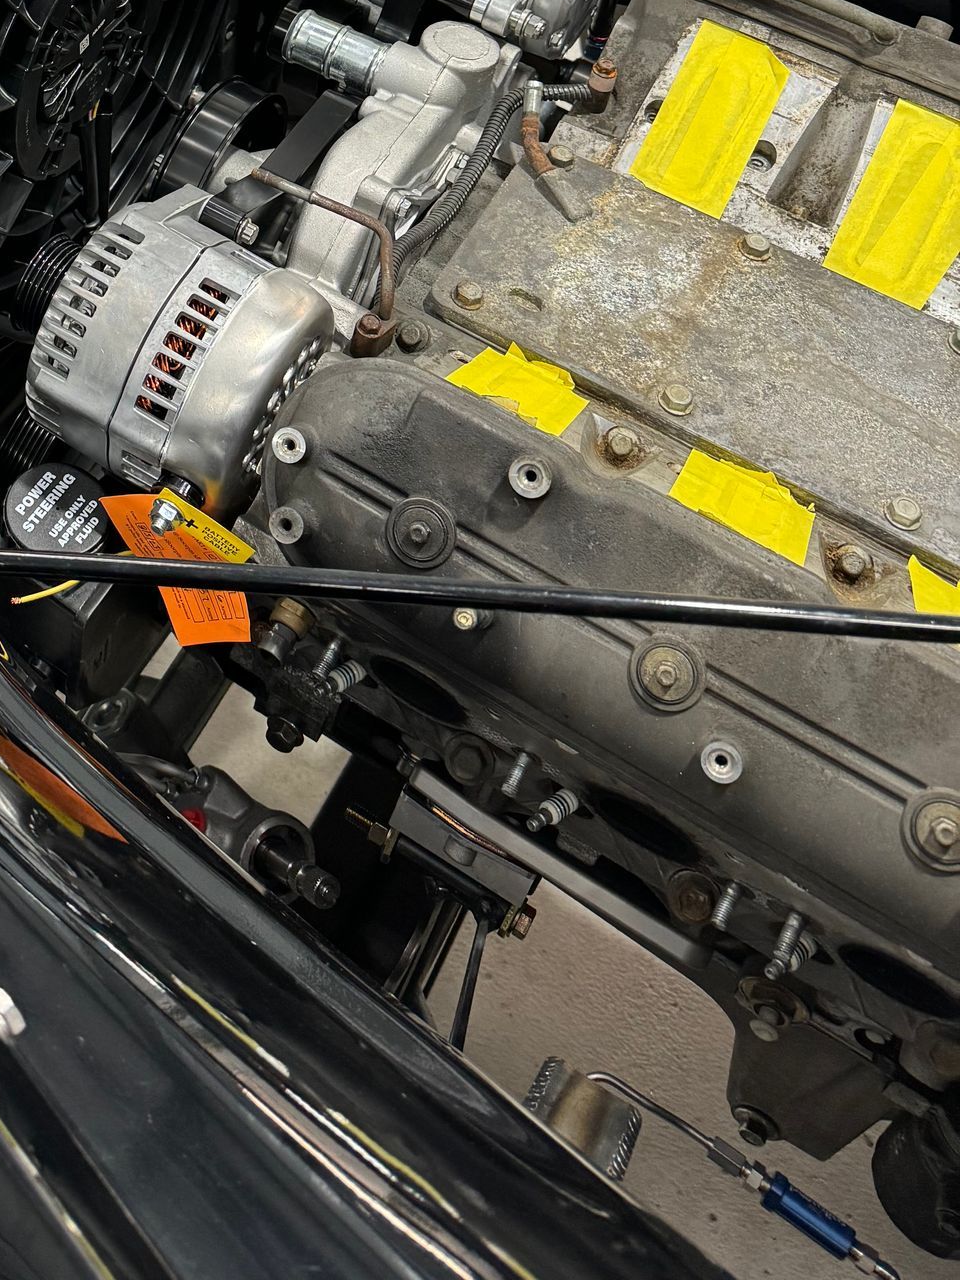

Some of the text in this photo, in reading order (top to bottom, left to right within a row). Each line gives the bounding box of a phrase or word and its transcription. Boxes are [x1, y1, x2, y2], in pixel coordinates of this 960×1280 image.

[14, 471, 57, 516] POWER
[22, 473, 76, 533] STEERING
[48, 494, 86, 538] USE ONLY
[57, 499, 98, 548] APPROVED
[74, 516, 99, 545] FLUID
[202, 530, 238, 556] POSITIVE
[203, 535, 230, 556] CABLE
[204, 526, 240, 552] BATTERY
